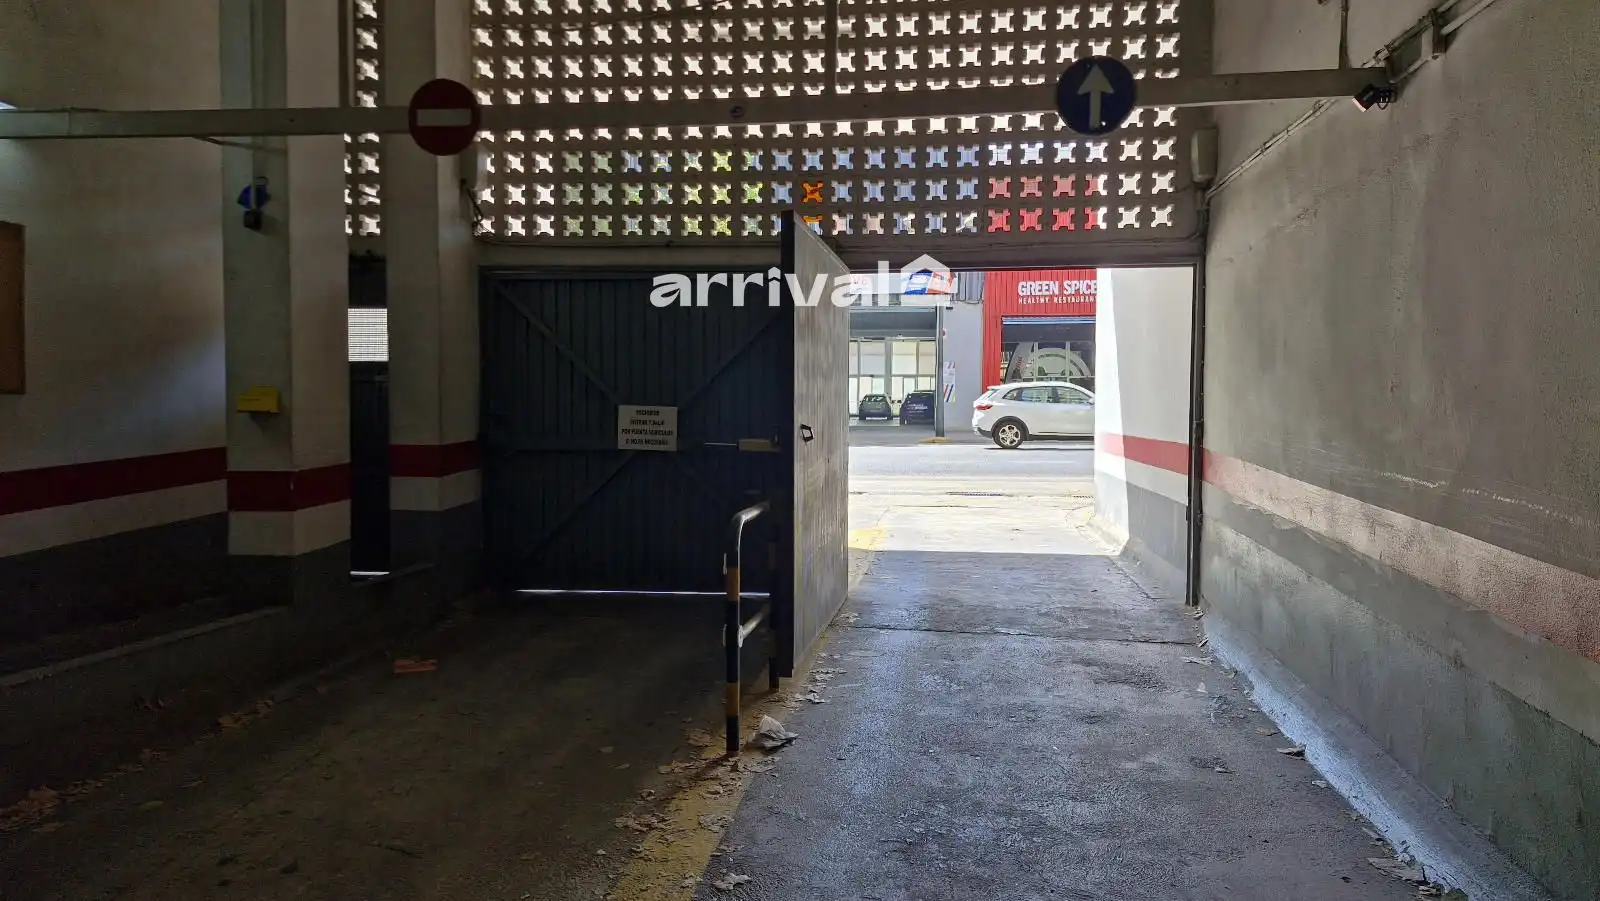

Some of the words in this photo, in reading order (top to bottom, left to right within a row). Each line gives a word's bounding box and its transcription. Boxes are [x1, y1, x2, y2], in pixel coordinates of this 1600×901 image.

[1018, 281, 1059, 296] GREEN
[1063, 280, 1097, 295] SPICE
[1019, 296, 1049, 304] HEALTHY
